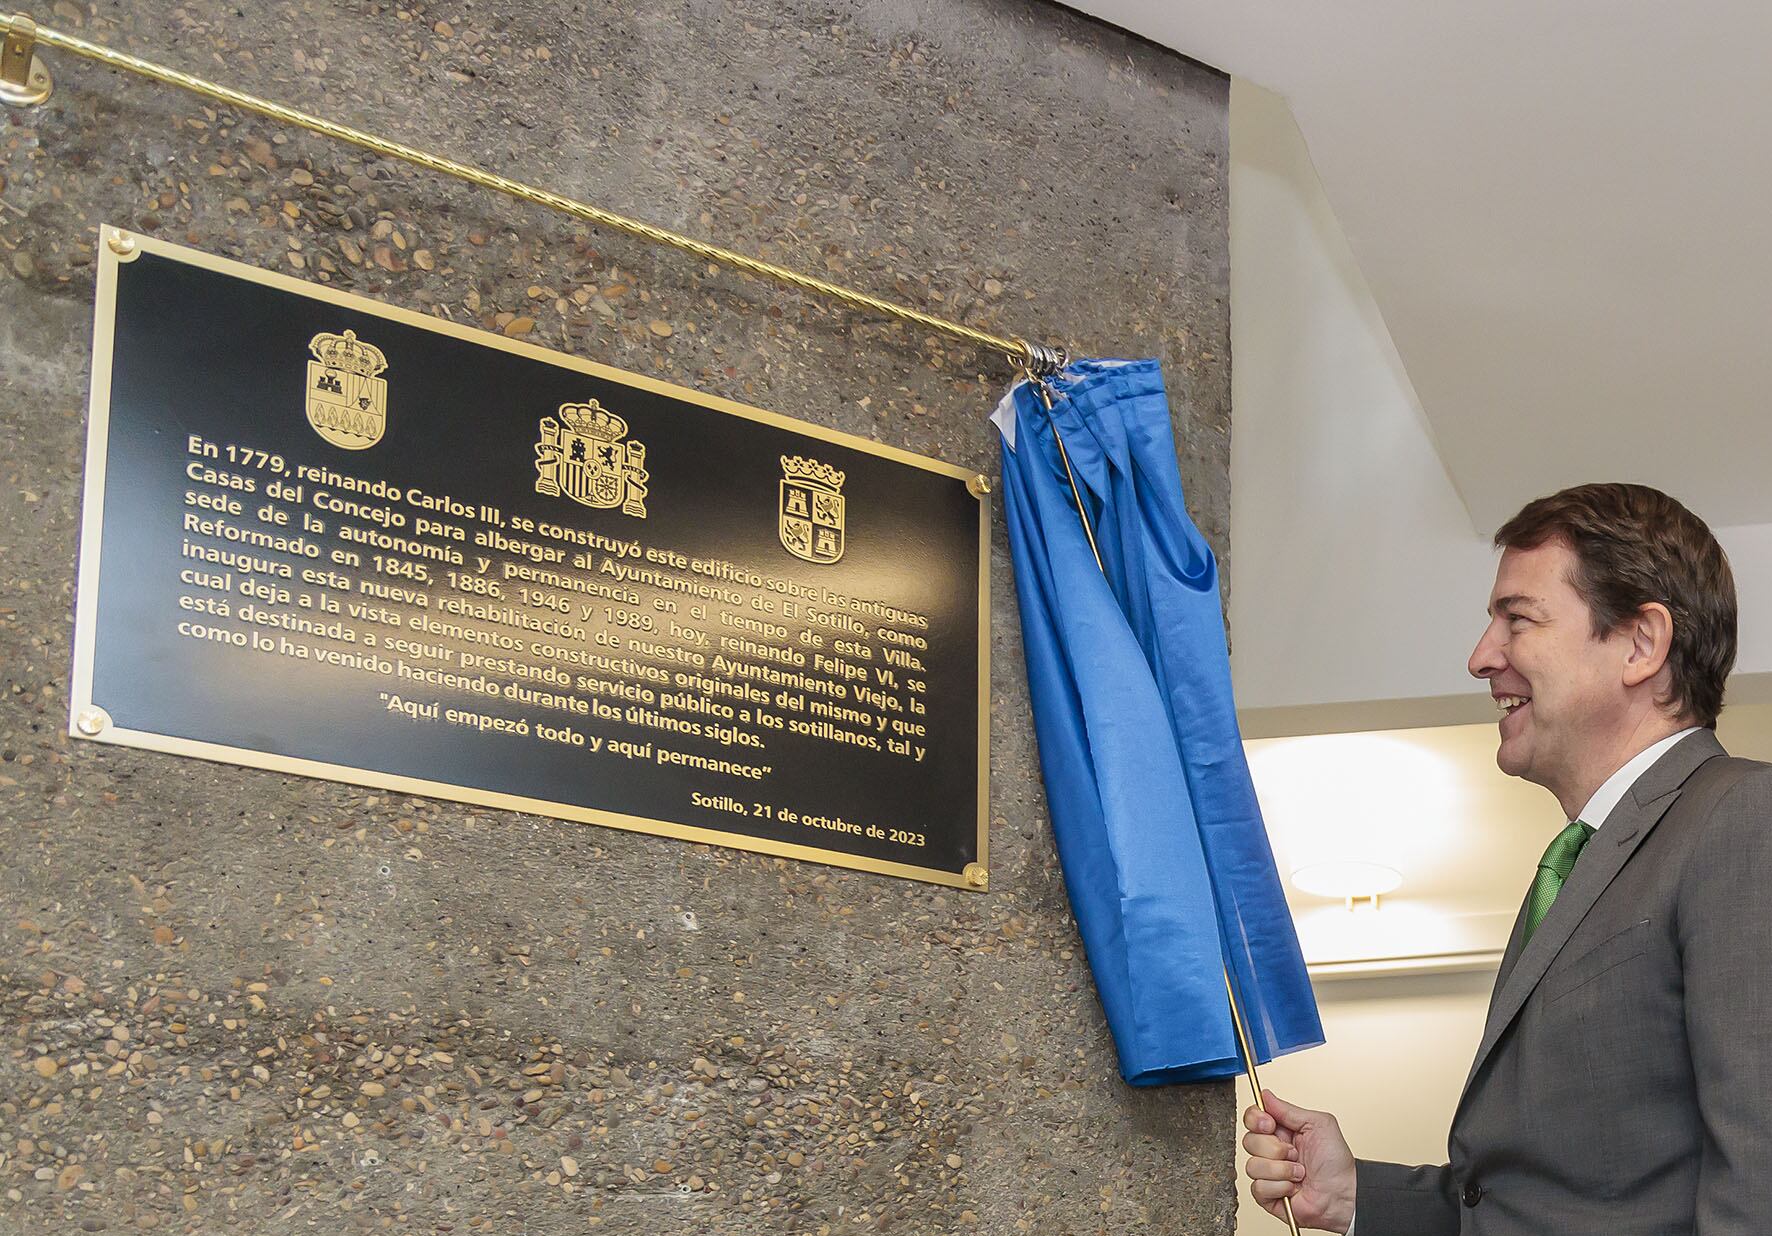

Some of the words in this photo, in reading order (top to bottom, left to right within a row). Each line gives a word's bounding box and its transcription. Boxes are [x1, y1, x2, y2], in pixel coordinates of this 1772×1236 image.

[184, 489, 242, 516] sede
[257, 502, 288, 526] de
[304, 513, 325, 534] la
[338, 524, 463, 565] autonomía
[478, 556, 491, 576] y
[504, 562, 640, 605] permanencia
[653, 596, 677, 614] en
[690, 604, 707, 621] el
[720, 609, 788, 641] tiempo
[800, 627, 823, 647] de
[834, 638, 872, 658] esta
[882, 646, 926, 671] Villa.
[184, 512, 320, 559] Reformado
[331, 548, 360, 567] en
[373, 554, 433, 587] 1845,
[447, 571, 505, 602] 1886,
[519, 587, 570, 614] 1946
[581, 603, 593, 623] y
[604, 606, 658, 636] 1989,
[670, 620, 710, 648] hoy,
[720, 635, 805, 666] reinando
[814, 653, 867, 682] Felipe
[875, 667, 899, 689] VI,
[907, 676, 926, 693] se
[186, 460, 256, 493] Casas
[266, 478, 302, 504] del
[313, 490, 406, 529] Concejo
[415, 517, 465, 541] para
[475, 530, 565, 564] albergar
[574, 553, 592, 571] al
[601, 557, 743, 606] Ayuntamiento
[751, 592, 774, 613] de
[782, 600, 798, 619] El
[807, 606, 869, 638] Sotillo,
[877, 625, 928, 649] como
[188, 435, 218, 459] En
[226, 444, 290, 479] 1779,
[298, 464, 401, 502] reinando
[406, 487, 475, 519] Carlos
[480, 505, 506, 530] III,
[511, 515, 534, 533] se
[538, 522, 642, 561] construyó
[646, 548, 687, 570] este
[691, 558, 762, 588] edificio
[767, 577, 818, 601] sobre
[822, 587, 846, 608] las
[850, 597, 927, 627] antiguas
[178, 618, 248, 646] como
[253, 630, 275, 652] lo
[281, 635, 309, 658] ha
[314, 646, 393, 675] venido
[398, 659, 500, 696] haciendo
[504, 680, 589, 713] durante
[593, 698, 622, 720] los
[626, 703, 702, 735] últimos
[704, 722, 765, 748] siglos.
[179, 593, 231, 617] está
[238, 601, 356, 642] destinada
[363, 630, 376, 646] a
[384, 635, 453, 662] seguir
[460, 650, 571, 686] prestando
[577, 674, 655, 703] servicio
[660, 690, 734, 719] público
[739, 708, 751, 722] a
[756, 708, 784, 729] los
[789, 718, 882, 752] sotillanos,
[887, 736, 910, 755] tal
[914, 744, 926, 762] y
[180, 567, 231, 591] cual
[239, 576, 290, 606] deja
[299, 592, 313, 608] a
[320, 593, 340, 614] la
[348, 601, 402, 627] vista
[408, 614, 524, 652] elementos
[530, 640, 669, 682] constructivos
[674, 671, 770, 704] originales
[775, 689, 804, 711] del
[810, 700, 872, 725] mismo
[876, 714, 888, 733] y
[892, 717, 926, 736] que
[182, 537, 292, 578] inaugura
[302, 567, 351, 591] esta
[360, 579, 429, 607] nueva
[438, 596, 586, 641] rehabilitación
[595, 627, 620, 648] de
[628, 638, 705, 667] nuestro
[711, 653, 847, 697] Ayuntamiento
[853, 684, 903, 712] Viejo,
[910, 696, 926, 714] la
[446, 706, 530, 736] empezó
[535, 721, 585, 746] todo
[590, 734, 603, 754] y
[607, 737, 652, 760] aquí
[691, 791, 748, 817] Sotillo,
[753, 803, 772, 819] 21
[777, 807, 798, 824] de
[802, 814, 862, 835] octubre
[865, 823, 885, 839] de
[889, 827, 925, 847] 2023
